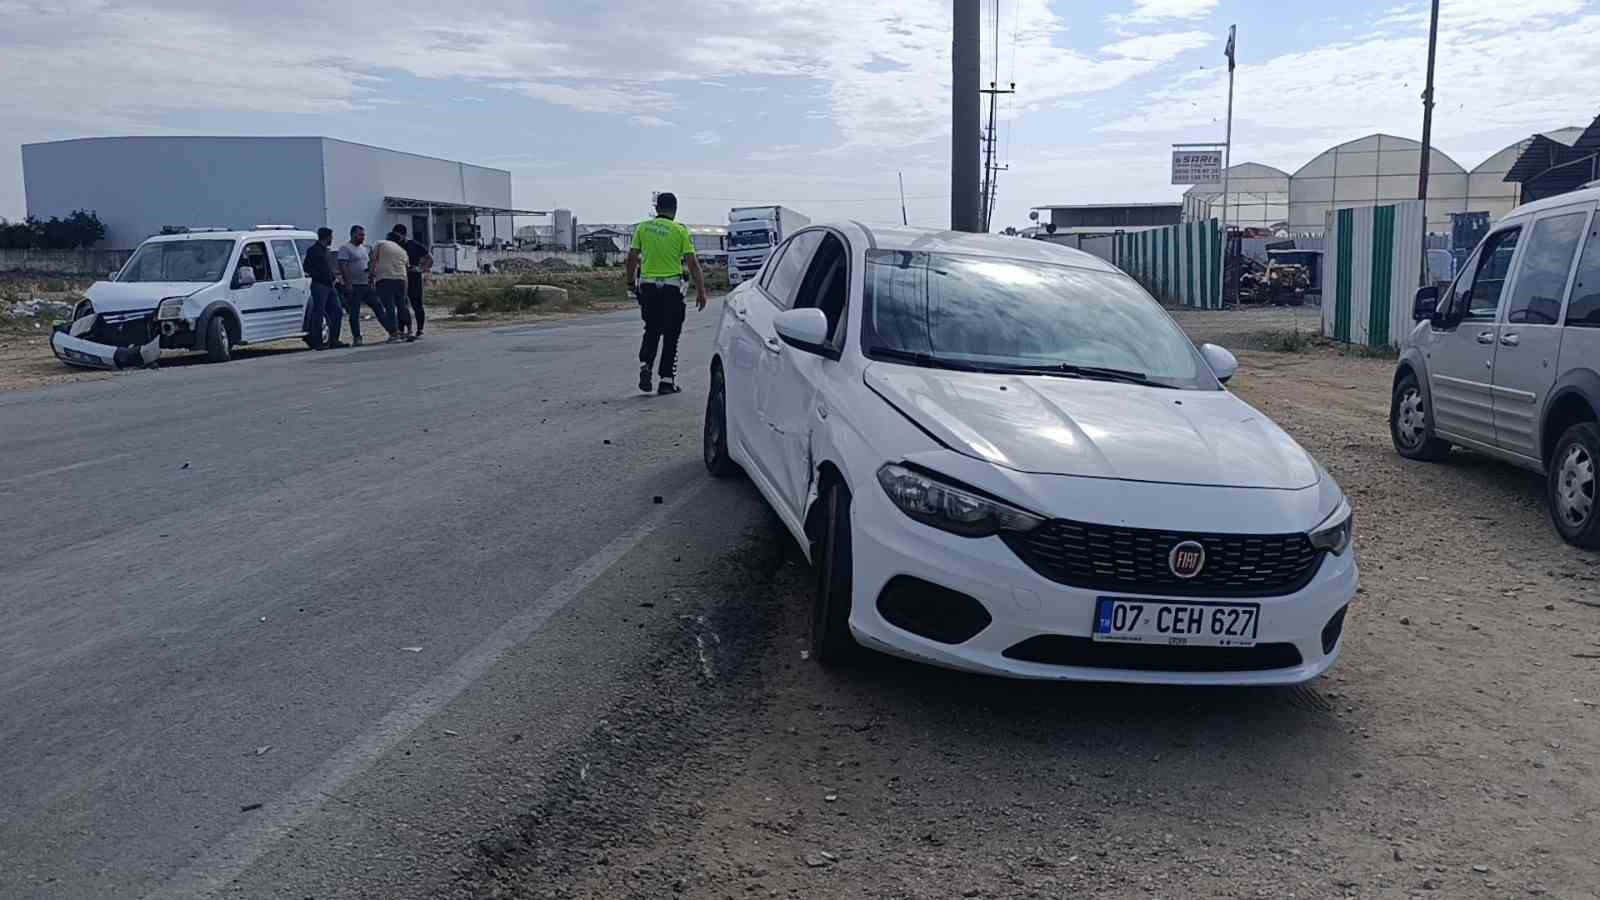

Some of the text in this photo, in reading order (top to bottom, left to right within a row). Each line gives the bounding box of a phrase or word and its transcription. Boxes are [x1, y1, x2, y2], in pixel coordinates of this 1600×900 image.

[1176, 552, 1200, 569] FIAT
[1113, 604, 1254, 636] 07 CEH 627
